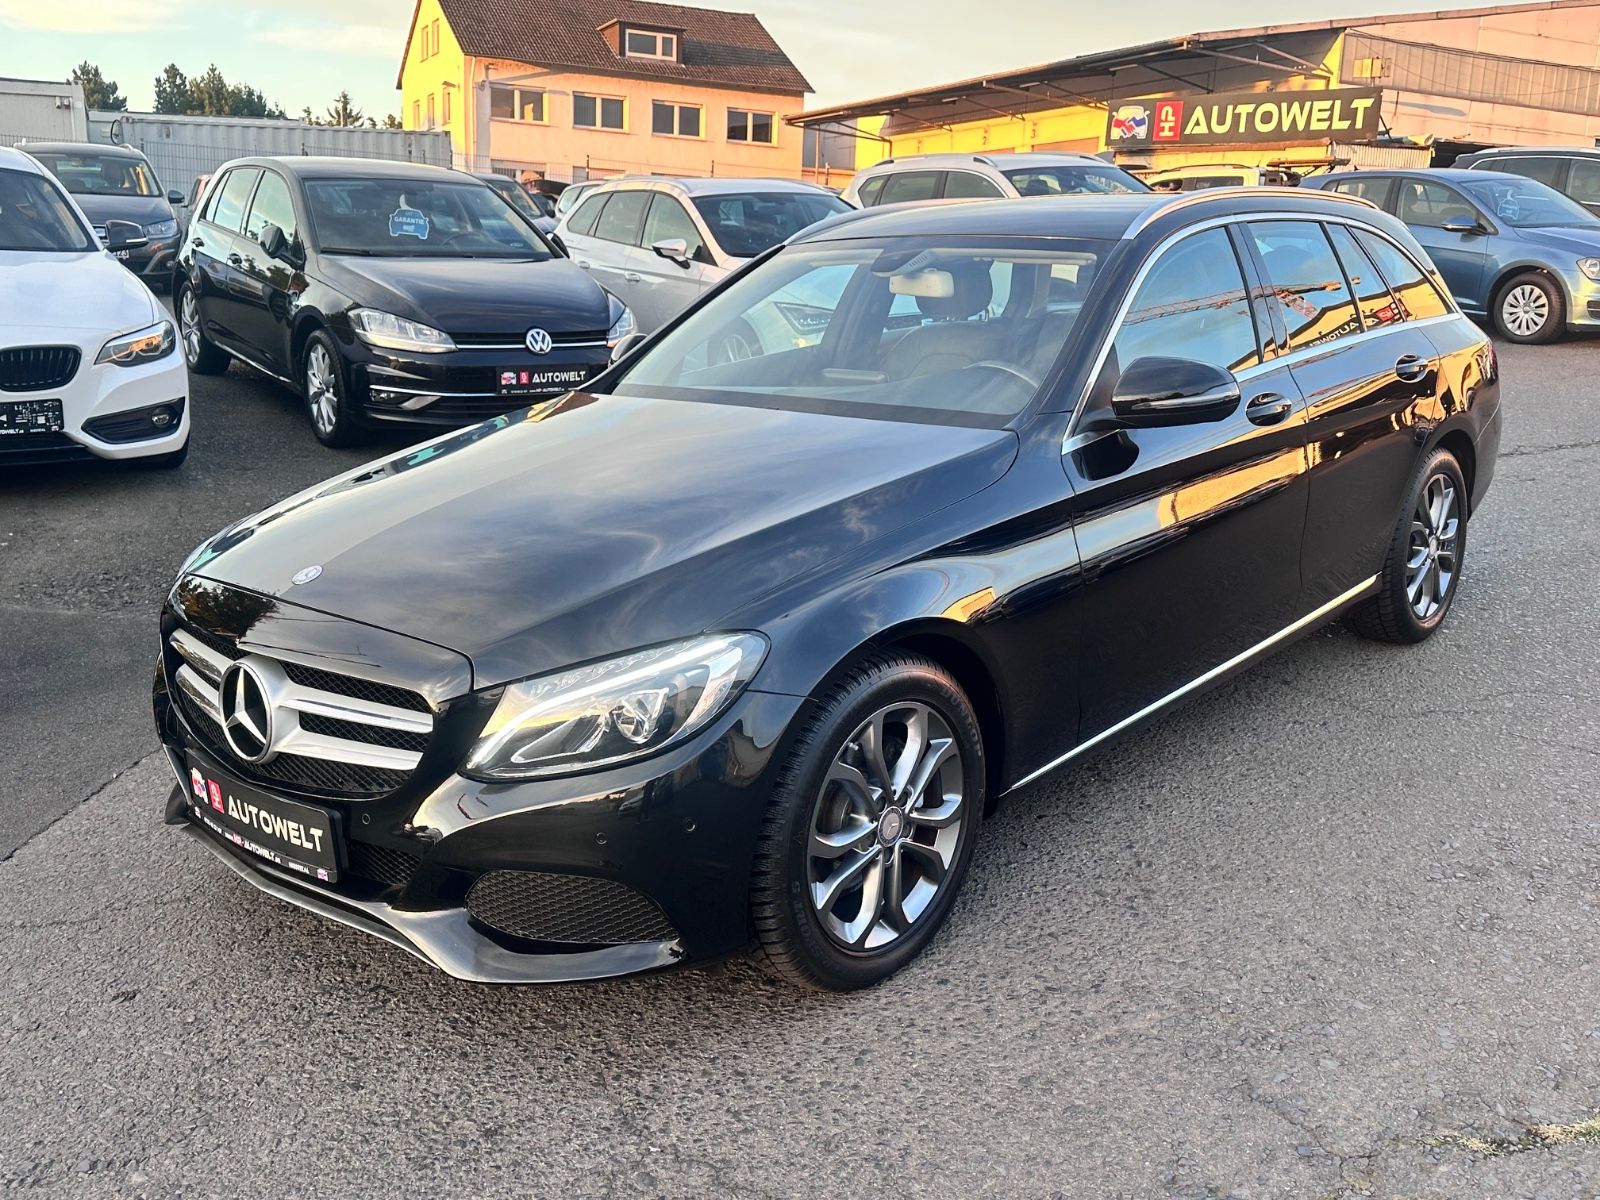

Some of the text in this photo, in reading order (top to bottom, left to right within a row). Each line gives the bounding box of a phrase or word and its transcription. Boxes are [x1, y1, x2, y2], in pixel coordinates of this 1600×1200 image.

[1184, 98, 1375, 135] AUTOWELT
[394, 216, 425, 225] GARANTIE
[532, 371, 586, 383] AUTOWELT
[228, 795, 324, 853] AUTOWELT
